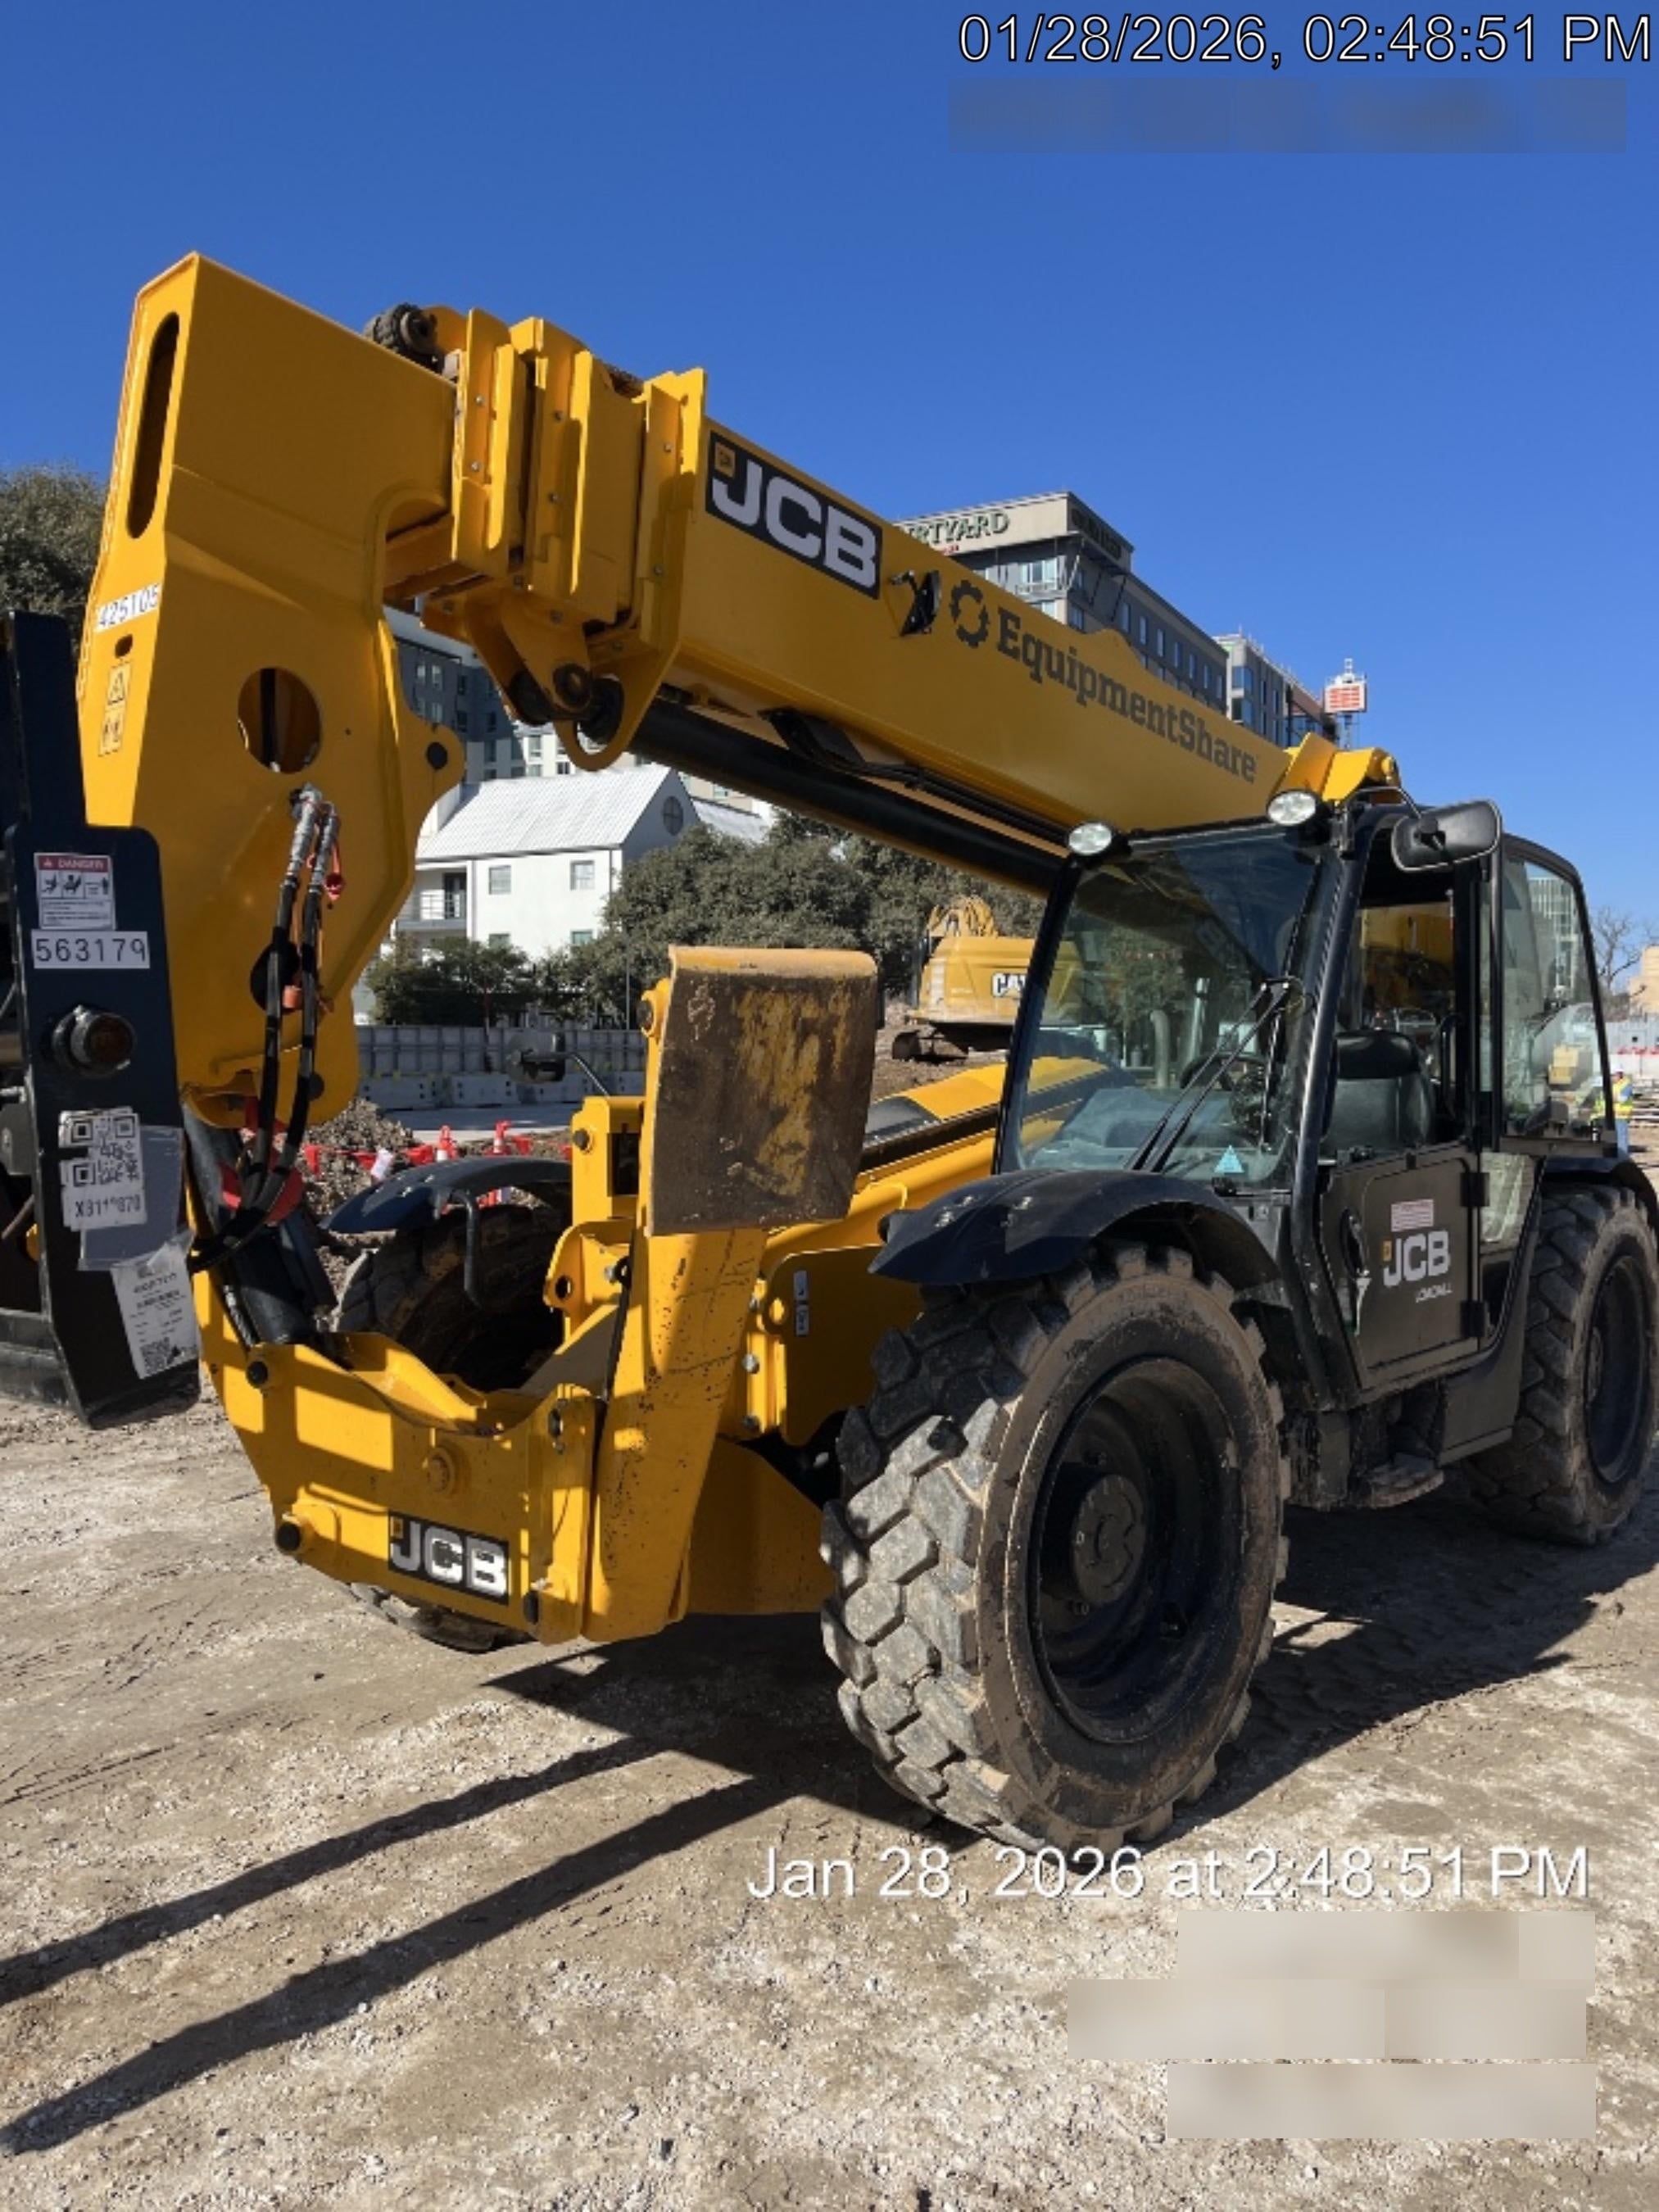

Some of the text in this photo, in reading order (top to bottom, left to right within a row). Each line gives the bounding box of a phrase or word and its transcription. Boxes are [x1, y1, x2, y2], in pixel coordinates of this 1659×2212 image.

[712, 459, 876, 587] JCB
[100, 583, 158, 626] 425105
[997, 606, 1255, 784] EquipmentShare
[36, 938, 145, 962] 563179
[1384, 1231, 1448, 1285] JCB
[391, 1521, 506, 1595] JCB
